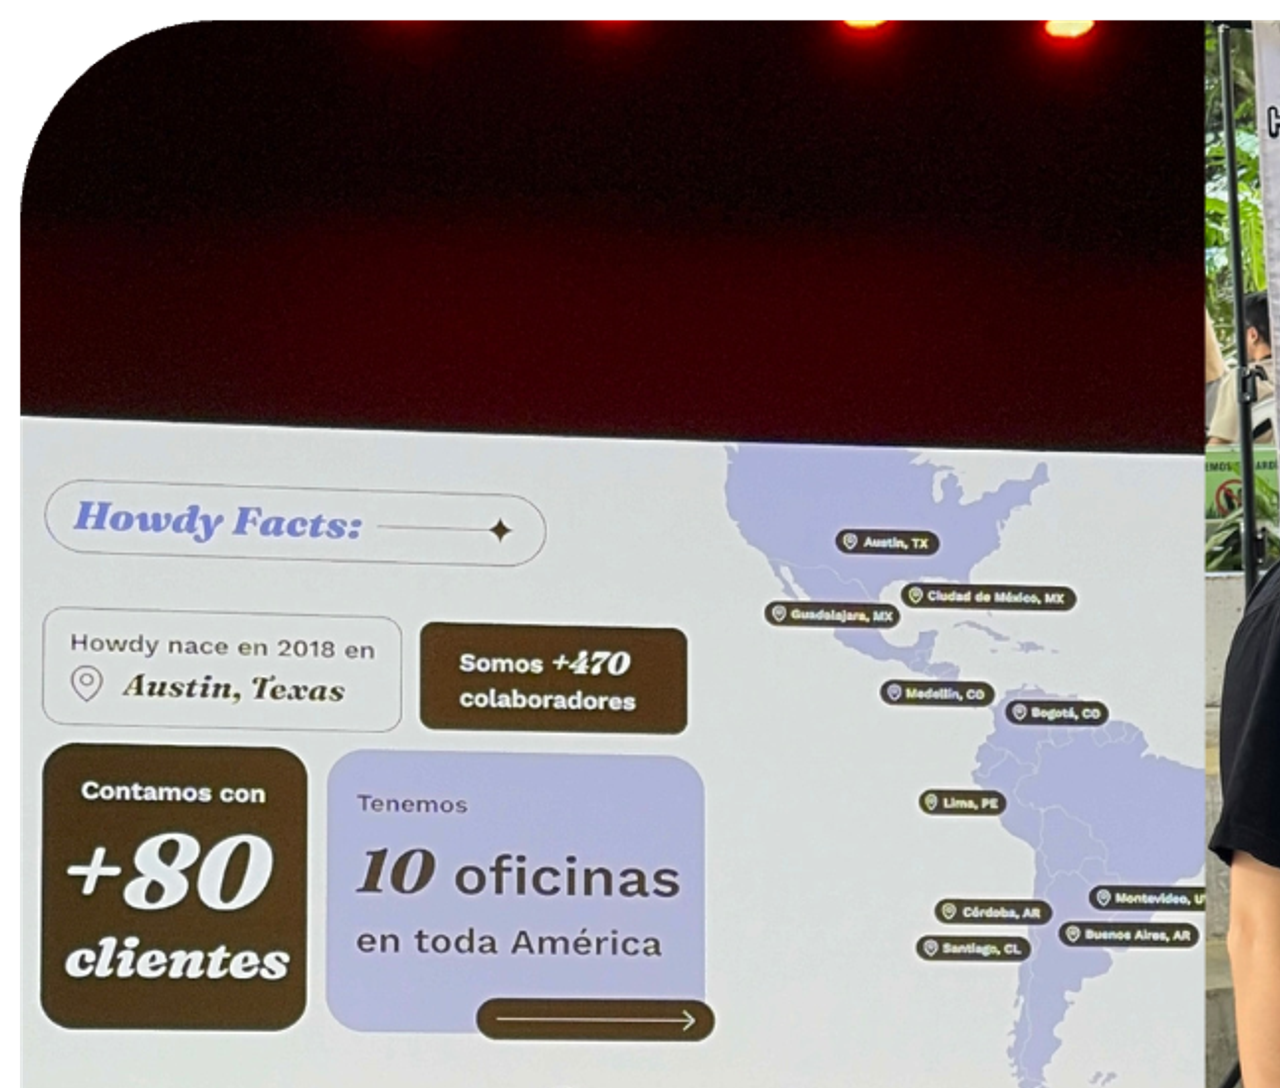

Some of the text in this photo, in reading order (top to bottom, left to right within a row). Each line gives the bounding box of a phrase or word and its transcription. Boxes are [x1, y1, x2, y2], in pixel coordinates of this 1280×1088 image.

[73, 500, 363, 544] Howdy Facts:
[863, 536, 929, 550] Austin, TX
[927, 589, 972, 603] Ciudad
[974, 590, 992, 603] de
[1045, 592, 1065, 604] MX
[791, 608, 893, 623] Guadalajara, MX
[71, 633, 375, 660] Howdy nace en 2018 en
[459, 650, 631, 677] Somos +470
[122, 673, 345, 703] Austin, Texas
[966, 689, 986, 700] CO
[459, 687, 637, 712] colaboradores
[1082, 708, 1101, 720] CO
[81, 780, 267, 804] Contamos con
[356, 793, 469, 815] Tenemos
[943, 797, 999, 811] Lima, PE
[66, 832, 274, 911] +80
[355, 847, 681, 899] 10 oficinas
[1115, 892, 1206, 906] Montevideo, U
[1022, 907, 1041, 919] AR
[356, 927, 662, 957] en toda América
[1084, 928, 1191, 943] Buenos Aires, AR
[64, 936, 291, 981] clientes
[942, 942, 1021, 957] Santiago, CL
